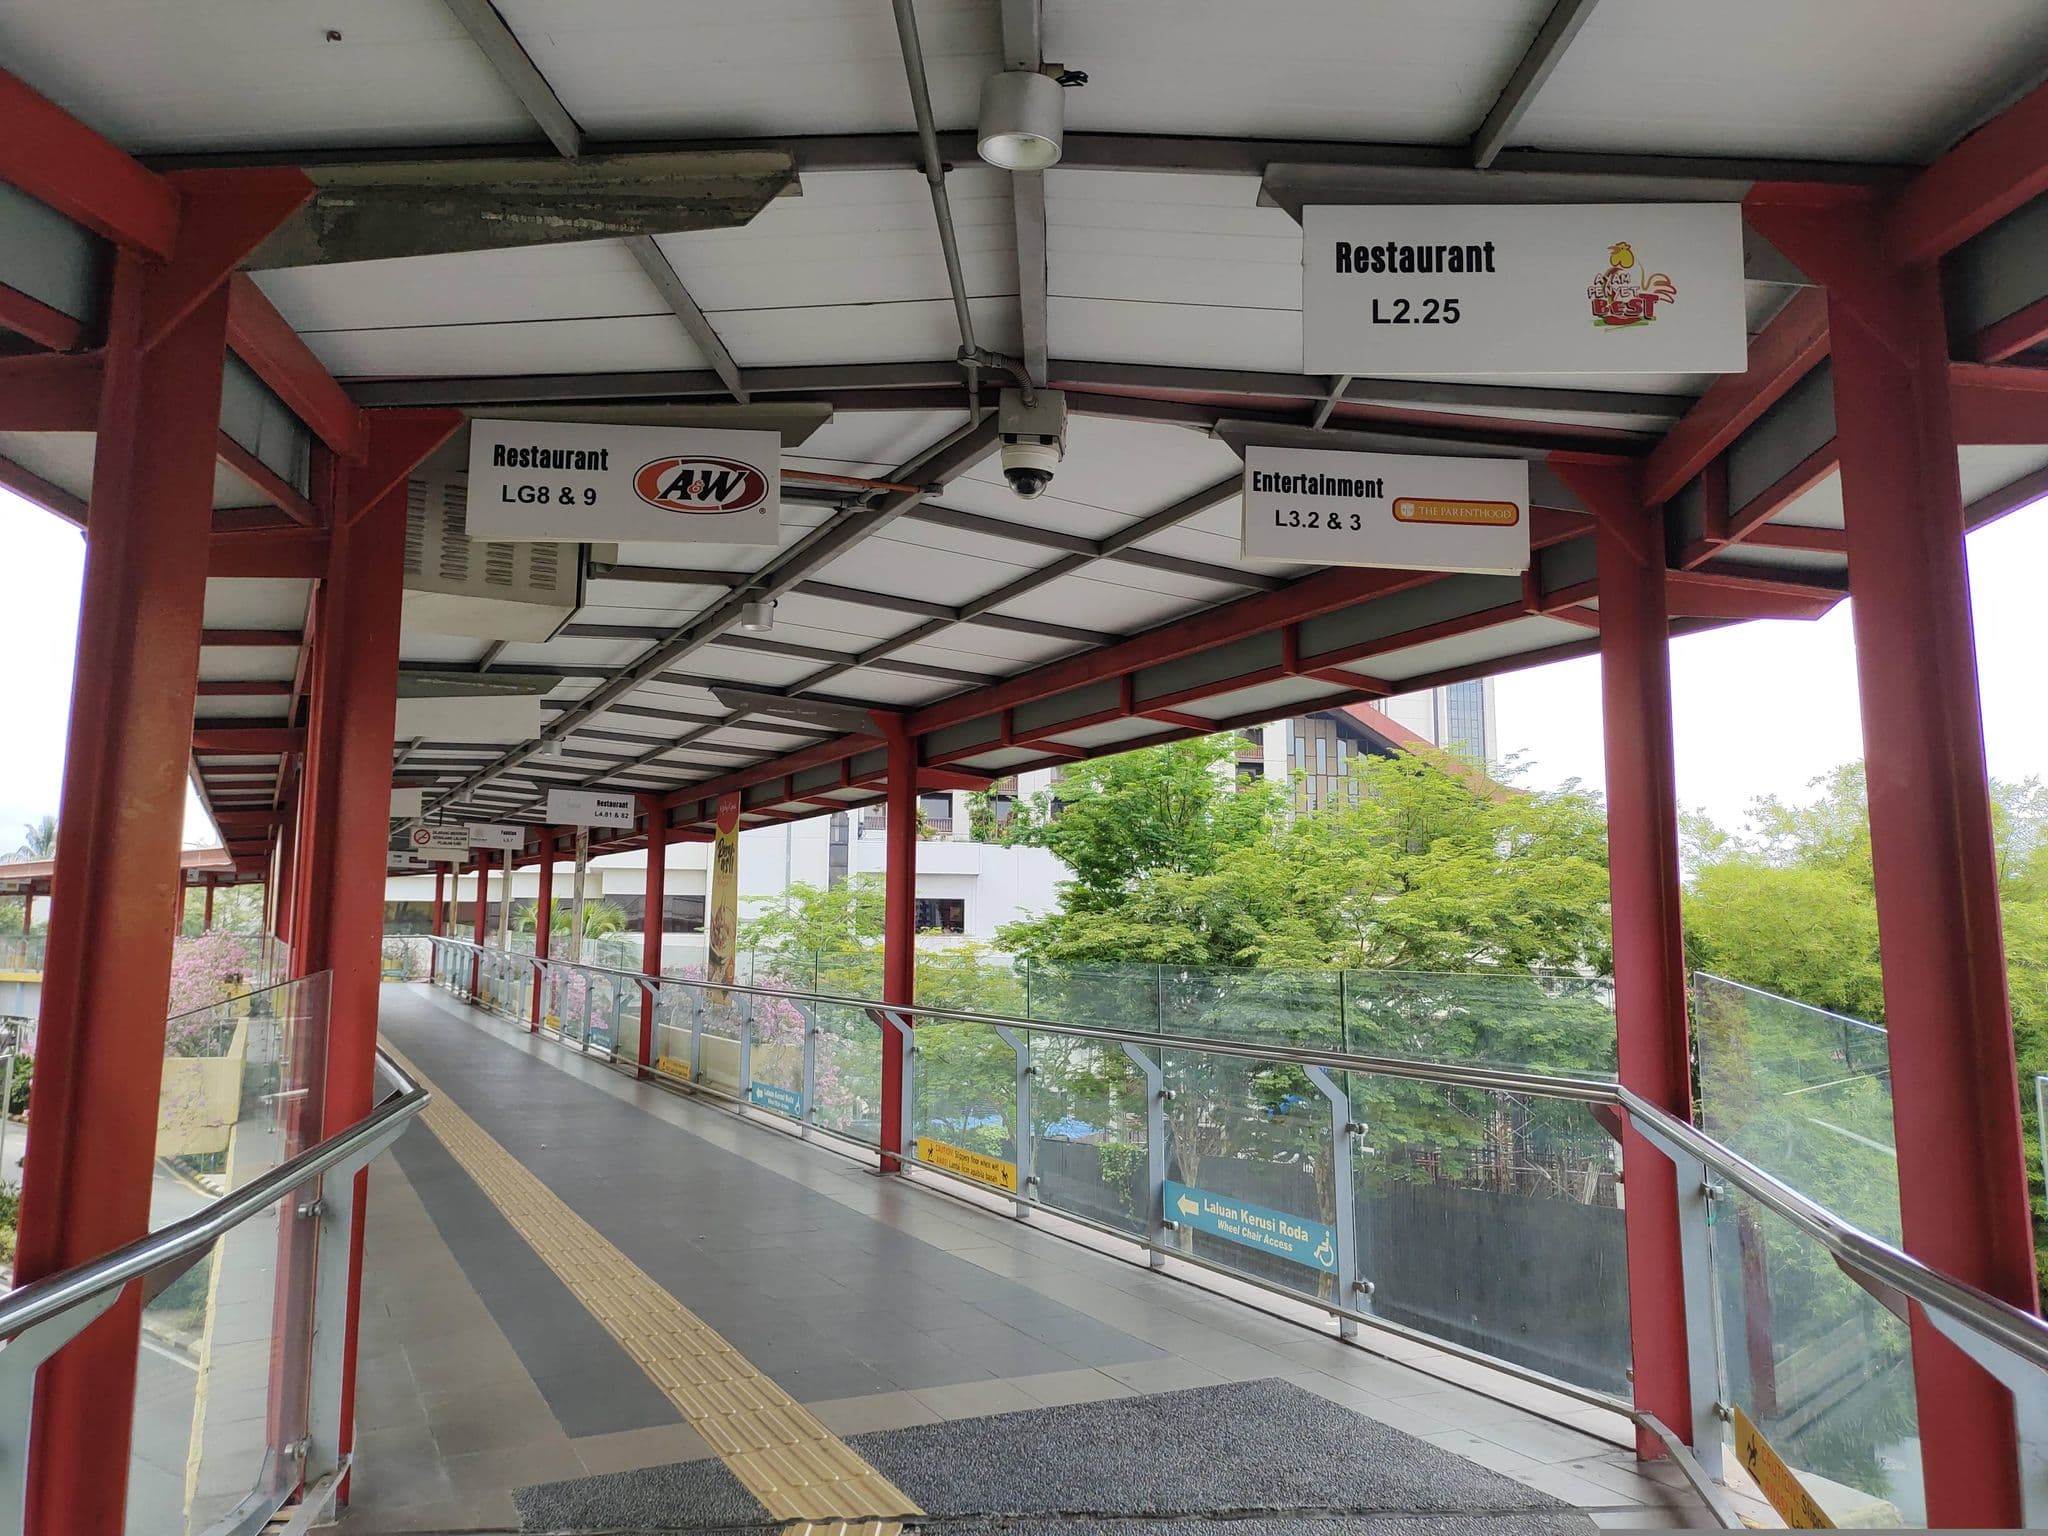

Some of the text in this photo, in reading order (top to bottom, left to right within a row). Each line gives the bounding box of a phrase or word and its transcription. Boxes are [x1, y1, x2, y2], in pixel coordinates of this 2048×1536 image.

[1335, 241, 1496, 274] Restaurant
[1594, 273, 1631, 285] AYAM
[1587, 286, 1640, 300] PENYET
[1371, 298, 1461, 325] L2.25
[493, 444, 609, 471] Restaurant
[502, 484, 597, 506] LG8 & 9
[653, 469, 750, 502] A&W
[1252, 470, 1384, 499] Entertainment
[1275, 509, 1362, 531] L3.2 & 3
[1418, 506, 1512, 519] THE PARENTHOOD
[597, 799, 629, 809] Restaurant
[1203, 1198, 1309, 1242] Laluan Kerusi Roda
[1217, 1219, 1294, 1252] Wheel Chair Access
